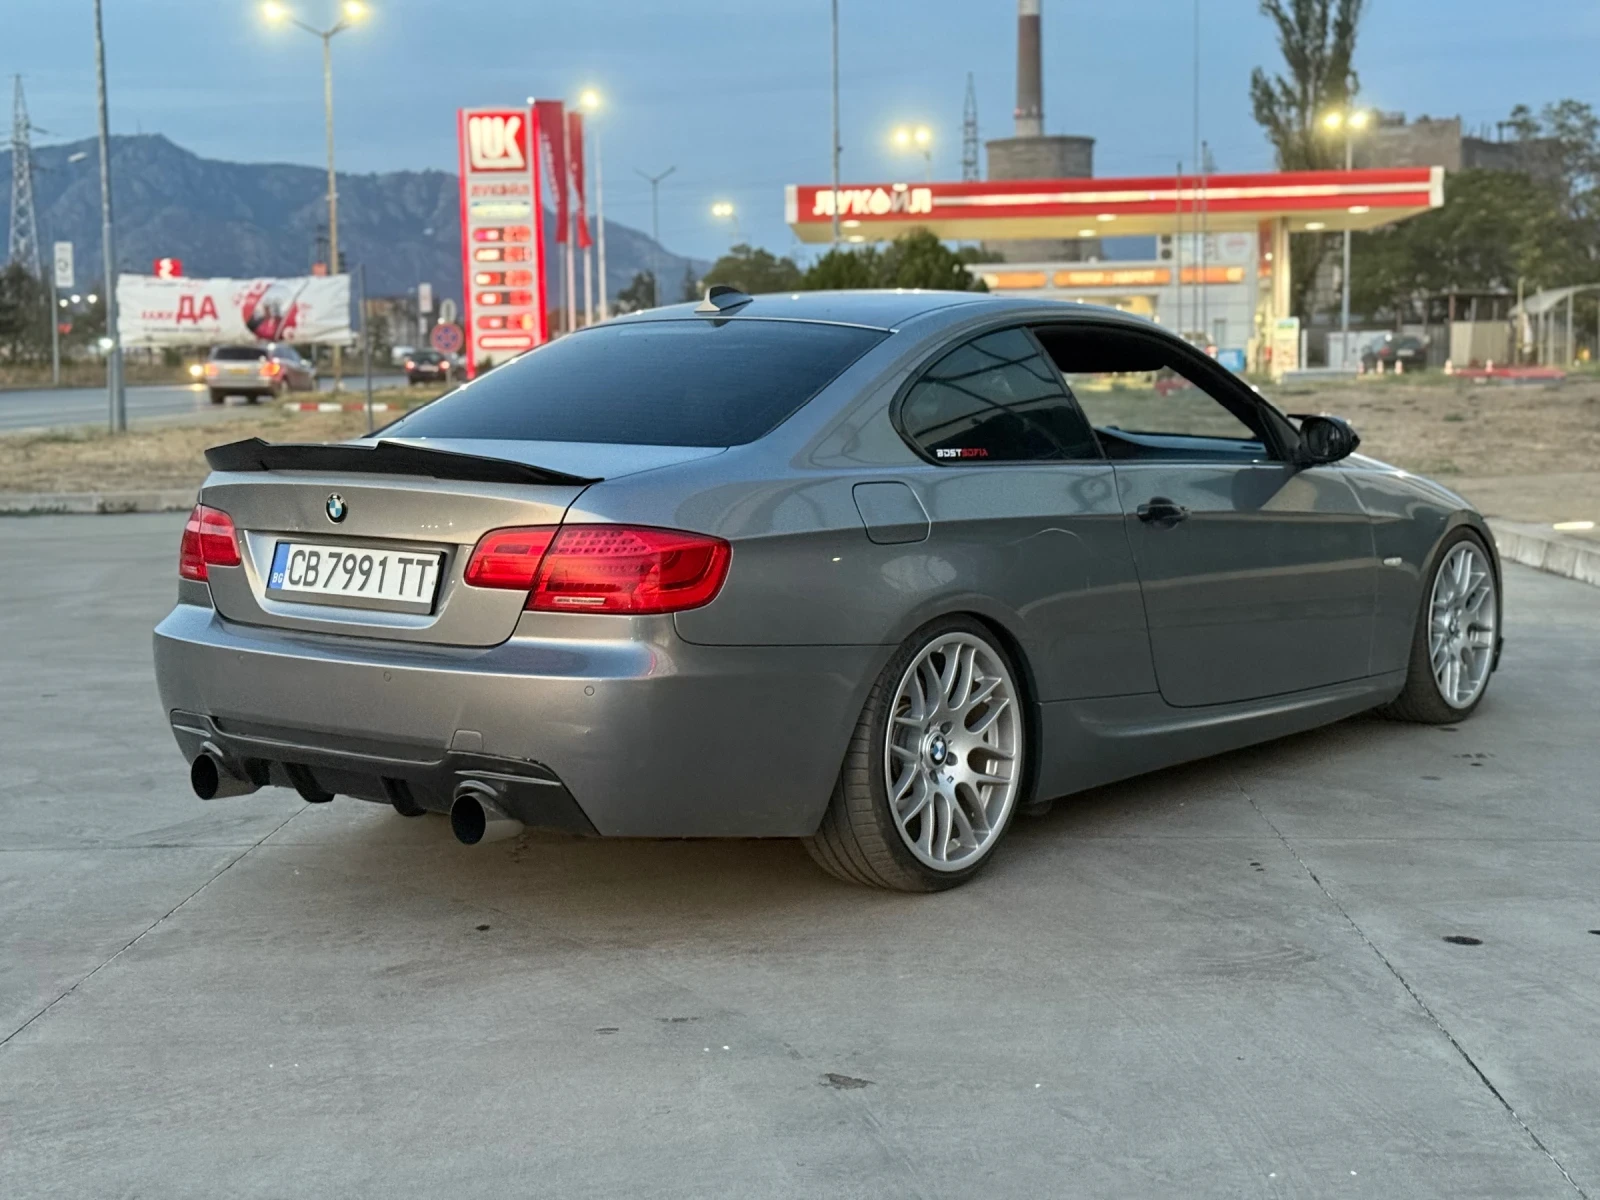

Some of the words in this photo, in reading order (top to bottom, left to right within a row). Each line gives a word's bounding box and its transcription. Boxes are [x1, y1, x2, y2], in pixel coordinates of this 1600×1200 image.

[812, 183, 932, 216] ЛУКОЙЛ
[176, 295, 219, 325] ДА
[271, 571, 284, 584] BG
[288, 549, 321, 588] CB
[322, 551, 389, 594] 7991
[397, 557, 434, 598] TT
